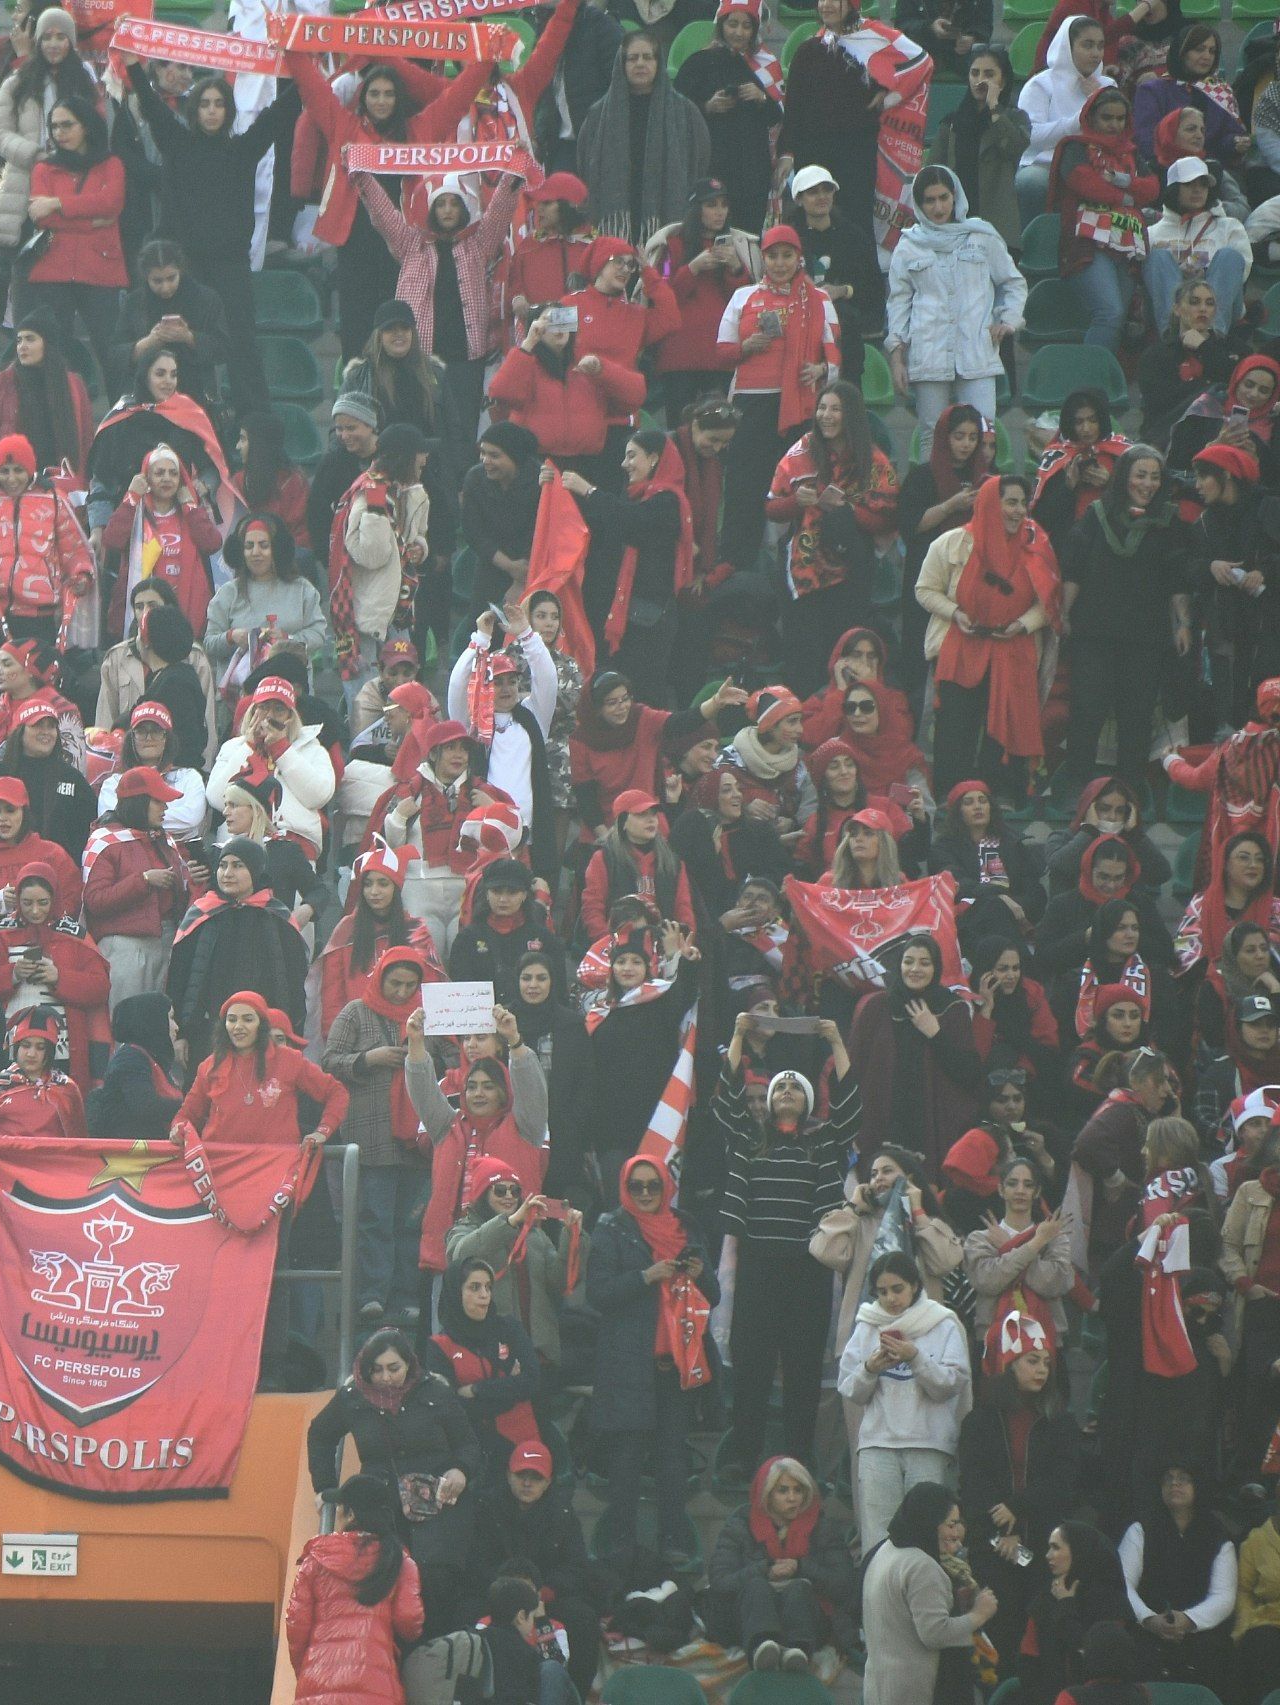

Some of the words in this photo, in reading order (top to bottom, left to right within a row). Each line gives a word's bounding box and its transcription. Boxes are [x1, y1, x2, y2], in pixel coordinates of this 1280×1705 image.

[303, 24, 331, 42] FC
[344, 26, 467, 51] PERSPOLIS
[378, 144, 516, 165] PERSPOLIS
[49, 1310, 75, 1325] ورزشی
[76, 1314, 109, 1329] فرهنگی
[110, 1318, 140, 1330] باشگاه
[33, 1354, 52, 1369] FC
[55, 1359, 141, 1379] PERSEPOLIS
[62, 1375, 86, 1386] Since
[89, 1378, 107, 1388] 1963
[49, 1563, 72, 1571] EXIT
